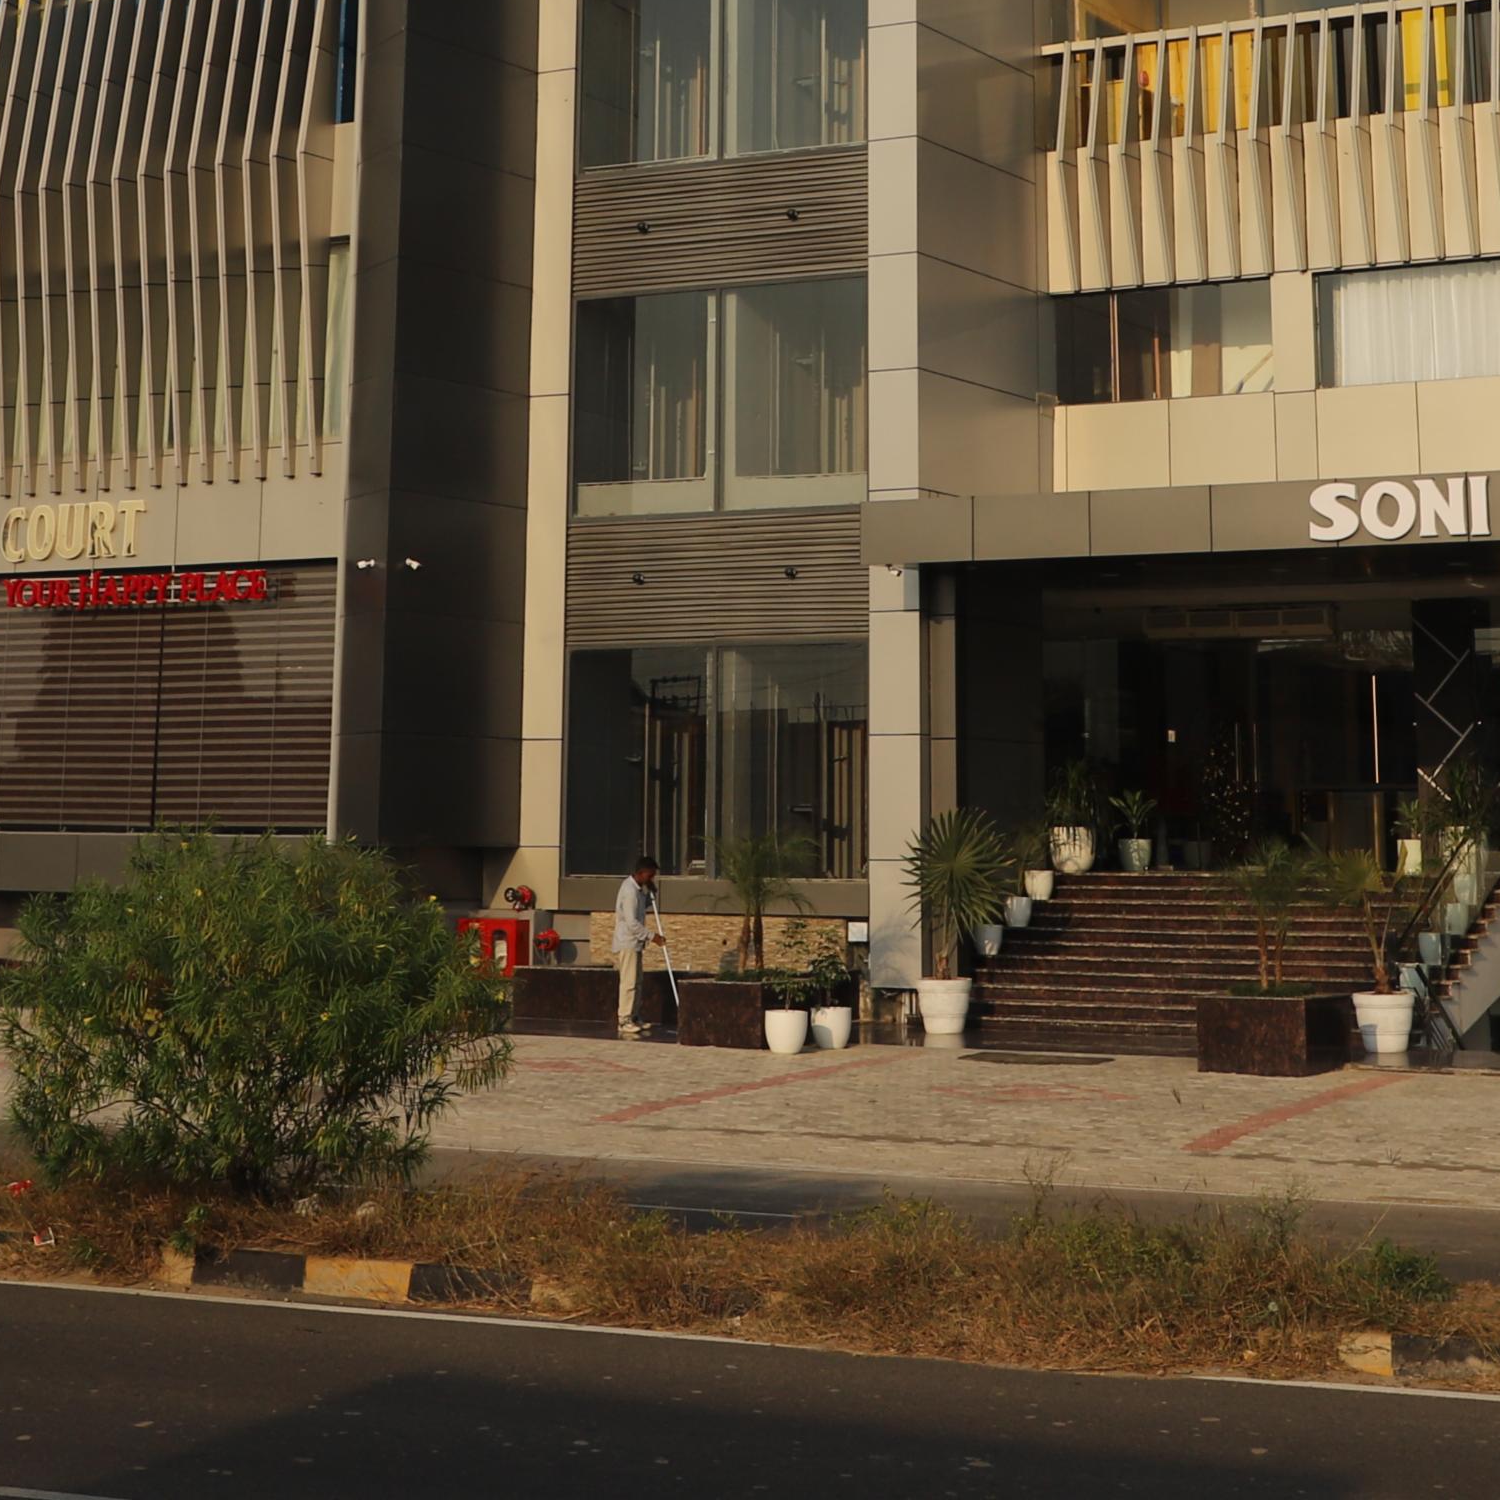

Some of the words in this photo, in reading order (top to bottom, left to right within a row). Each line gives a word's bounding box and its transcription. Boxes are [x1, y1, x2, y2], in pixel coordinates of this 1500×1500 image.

[2, 500, 145, 563] COURT
[1308, 475, 1491, 542] SONI
[3, 578, 71, 608] YOUR
[73, 569, 175, 611] HAPPY
[179, 569, 267, 602] PLACE
